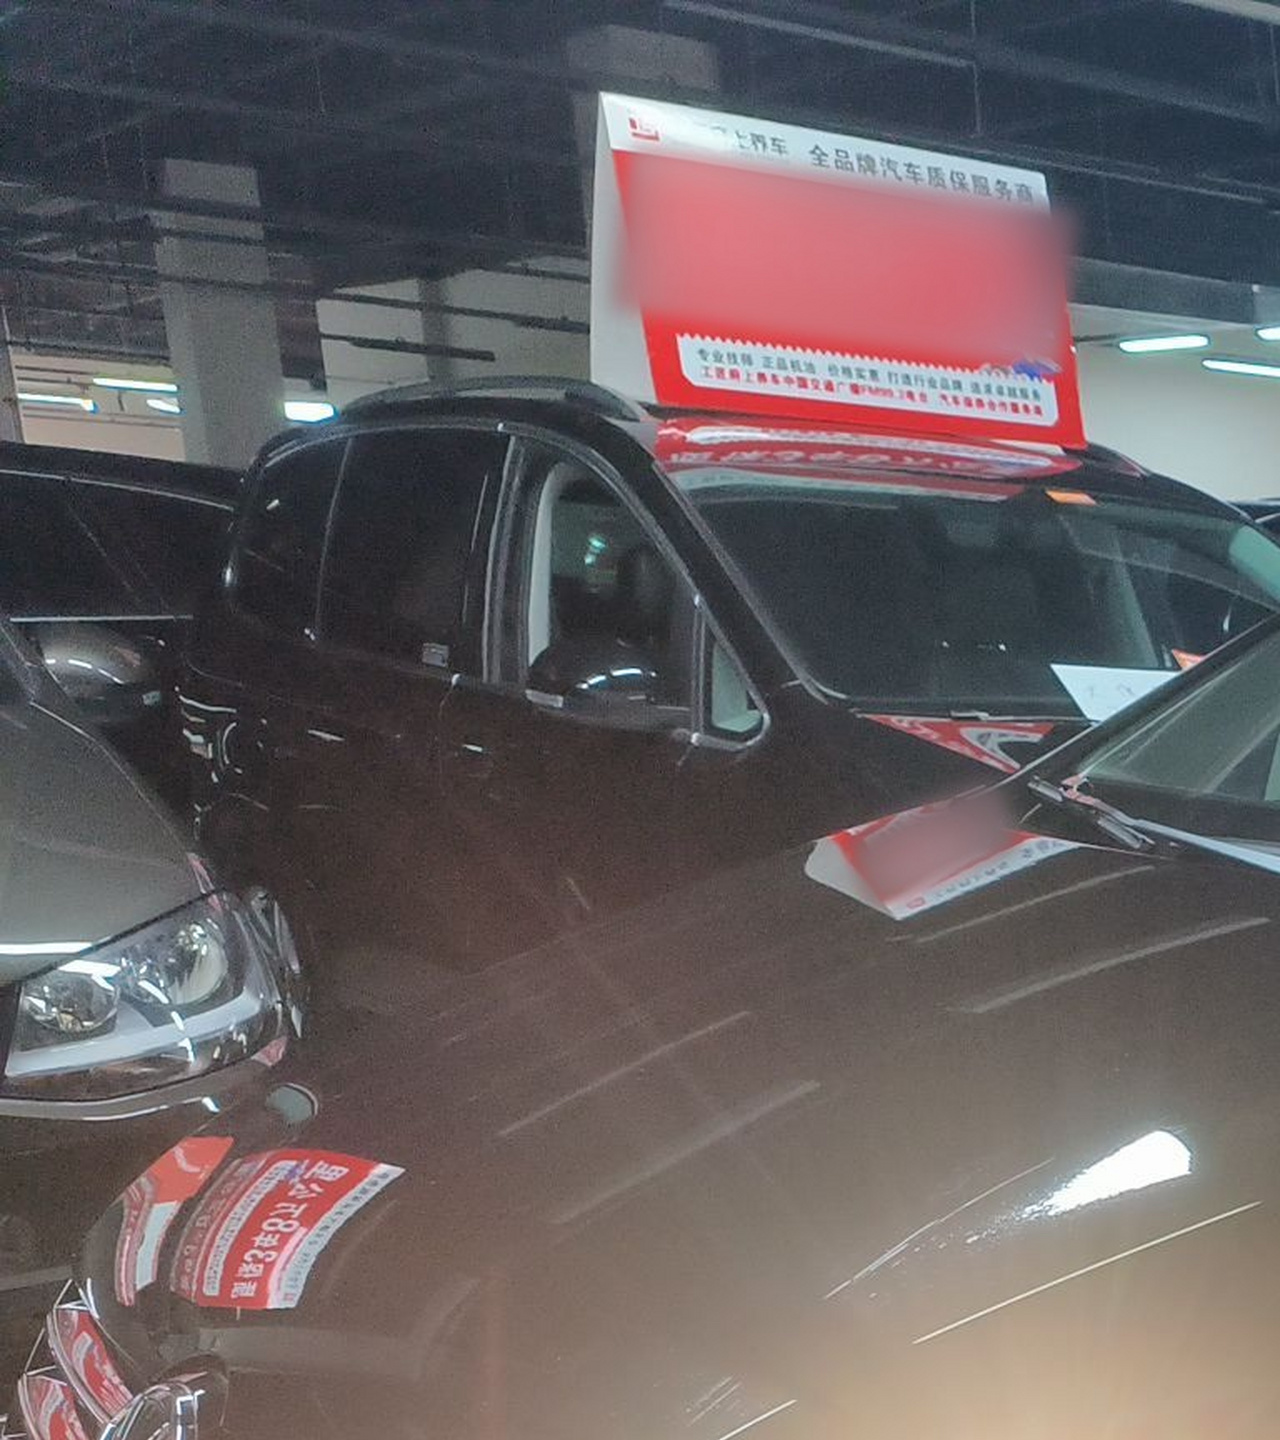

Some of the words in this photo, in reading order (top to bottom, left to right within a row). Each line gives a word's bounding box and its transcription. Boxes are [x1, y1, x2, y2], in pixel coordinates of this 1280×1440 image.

[809, 144, 1033, 204] 全品牌汽车质保服务商
